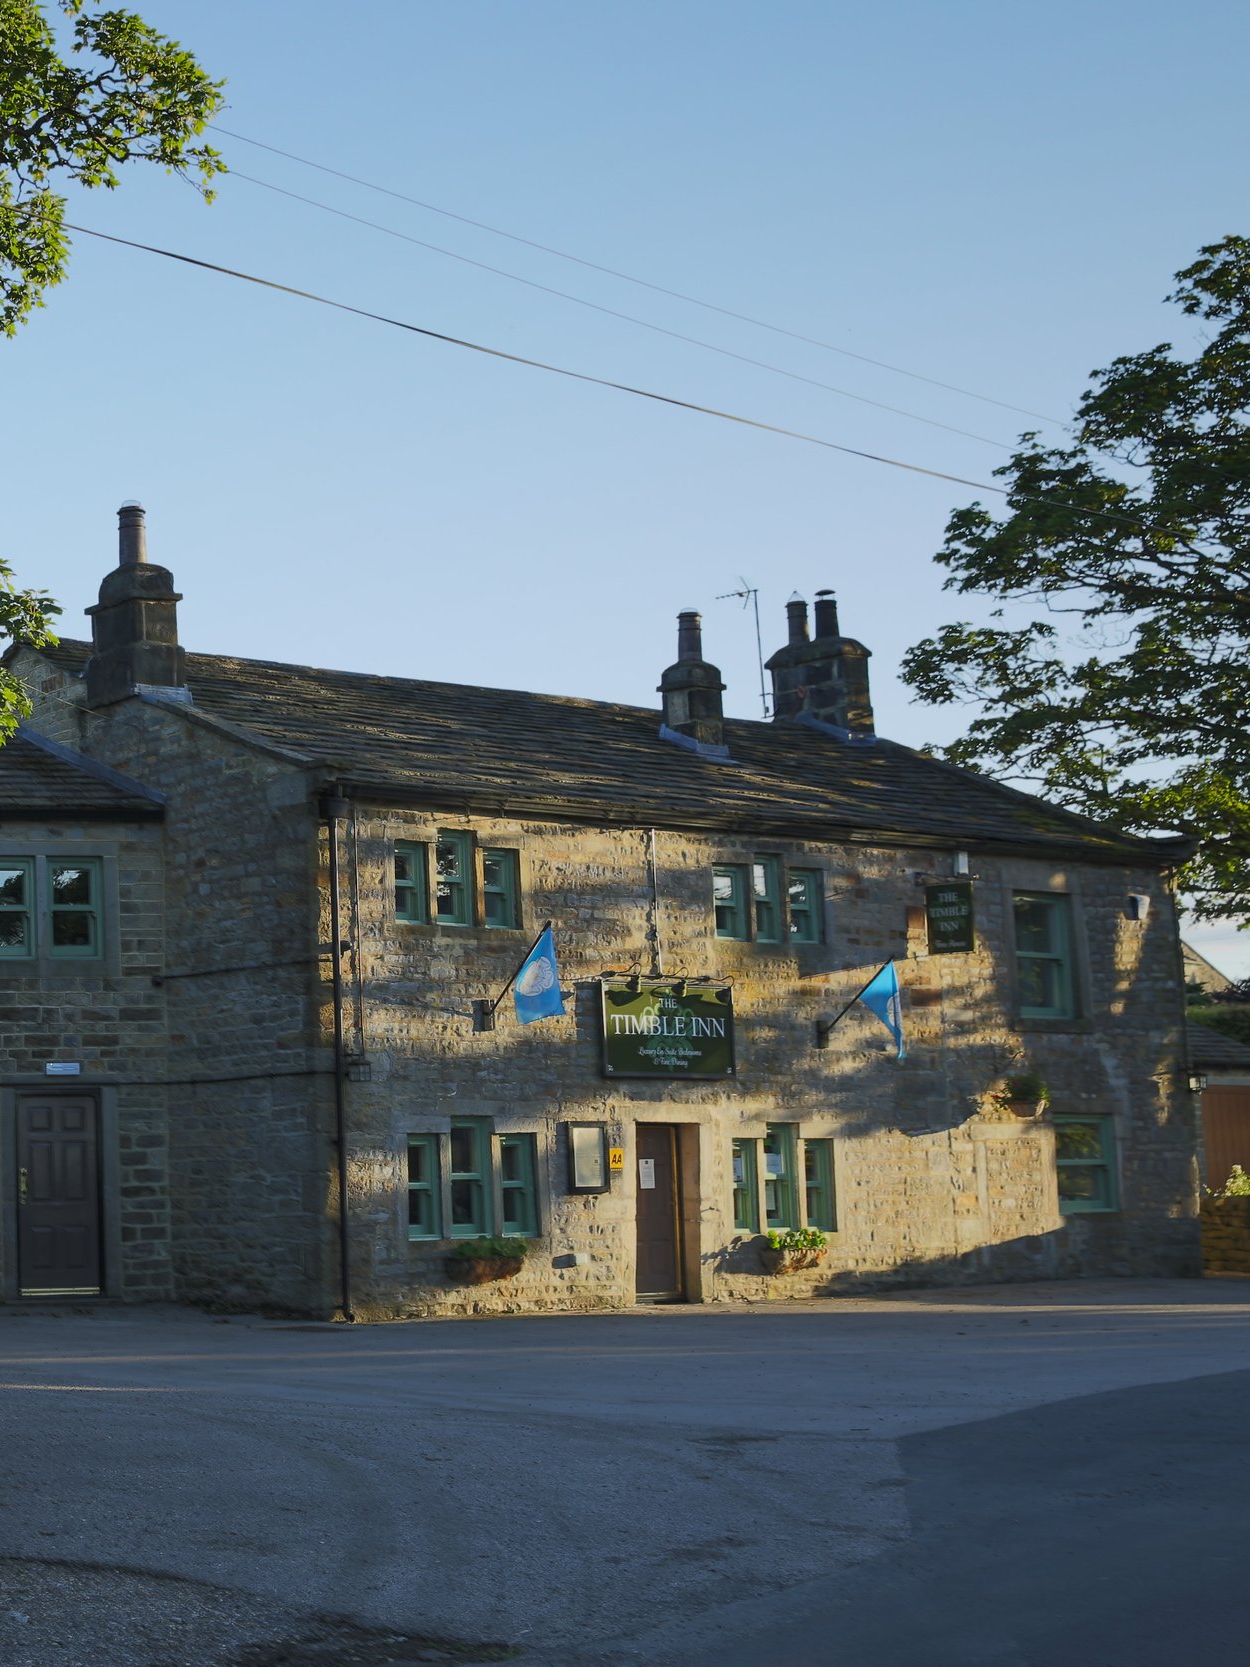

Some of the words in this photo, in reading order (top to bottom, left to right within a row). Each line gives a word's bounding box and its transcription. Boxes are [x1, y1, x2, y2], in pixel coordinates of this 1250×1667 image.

[938, 892, 958, 902] THE
[929, 907, 968, 918] TIMBLE
[941, 921, 958, 931] INN
[659, 998, 678, 1008] THE
[611, 1014, 686, 1037] TIMBLE
[691, 1017, 725, 1038] INN
[611, 1154, 622, 1164] AA
